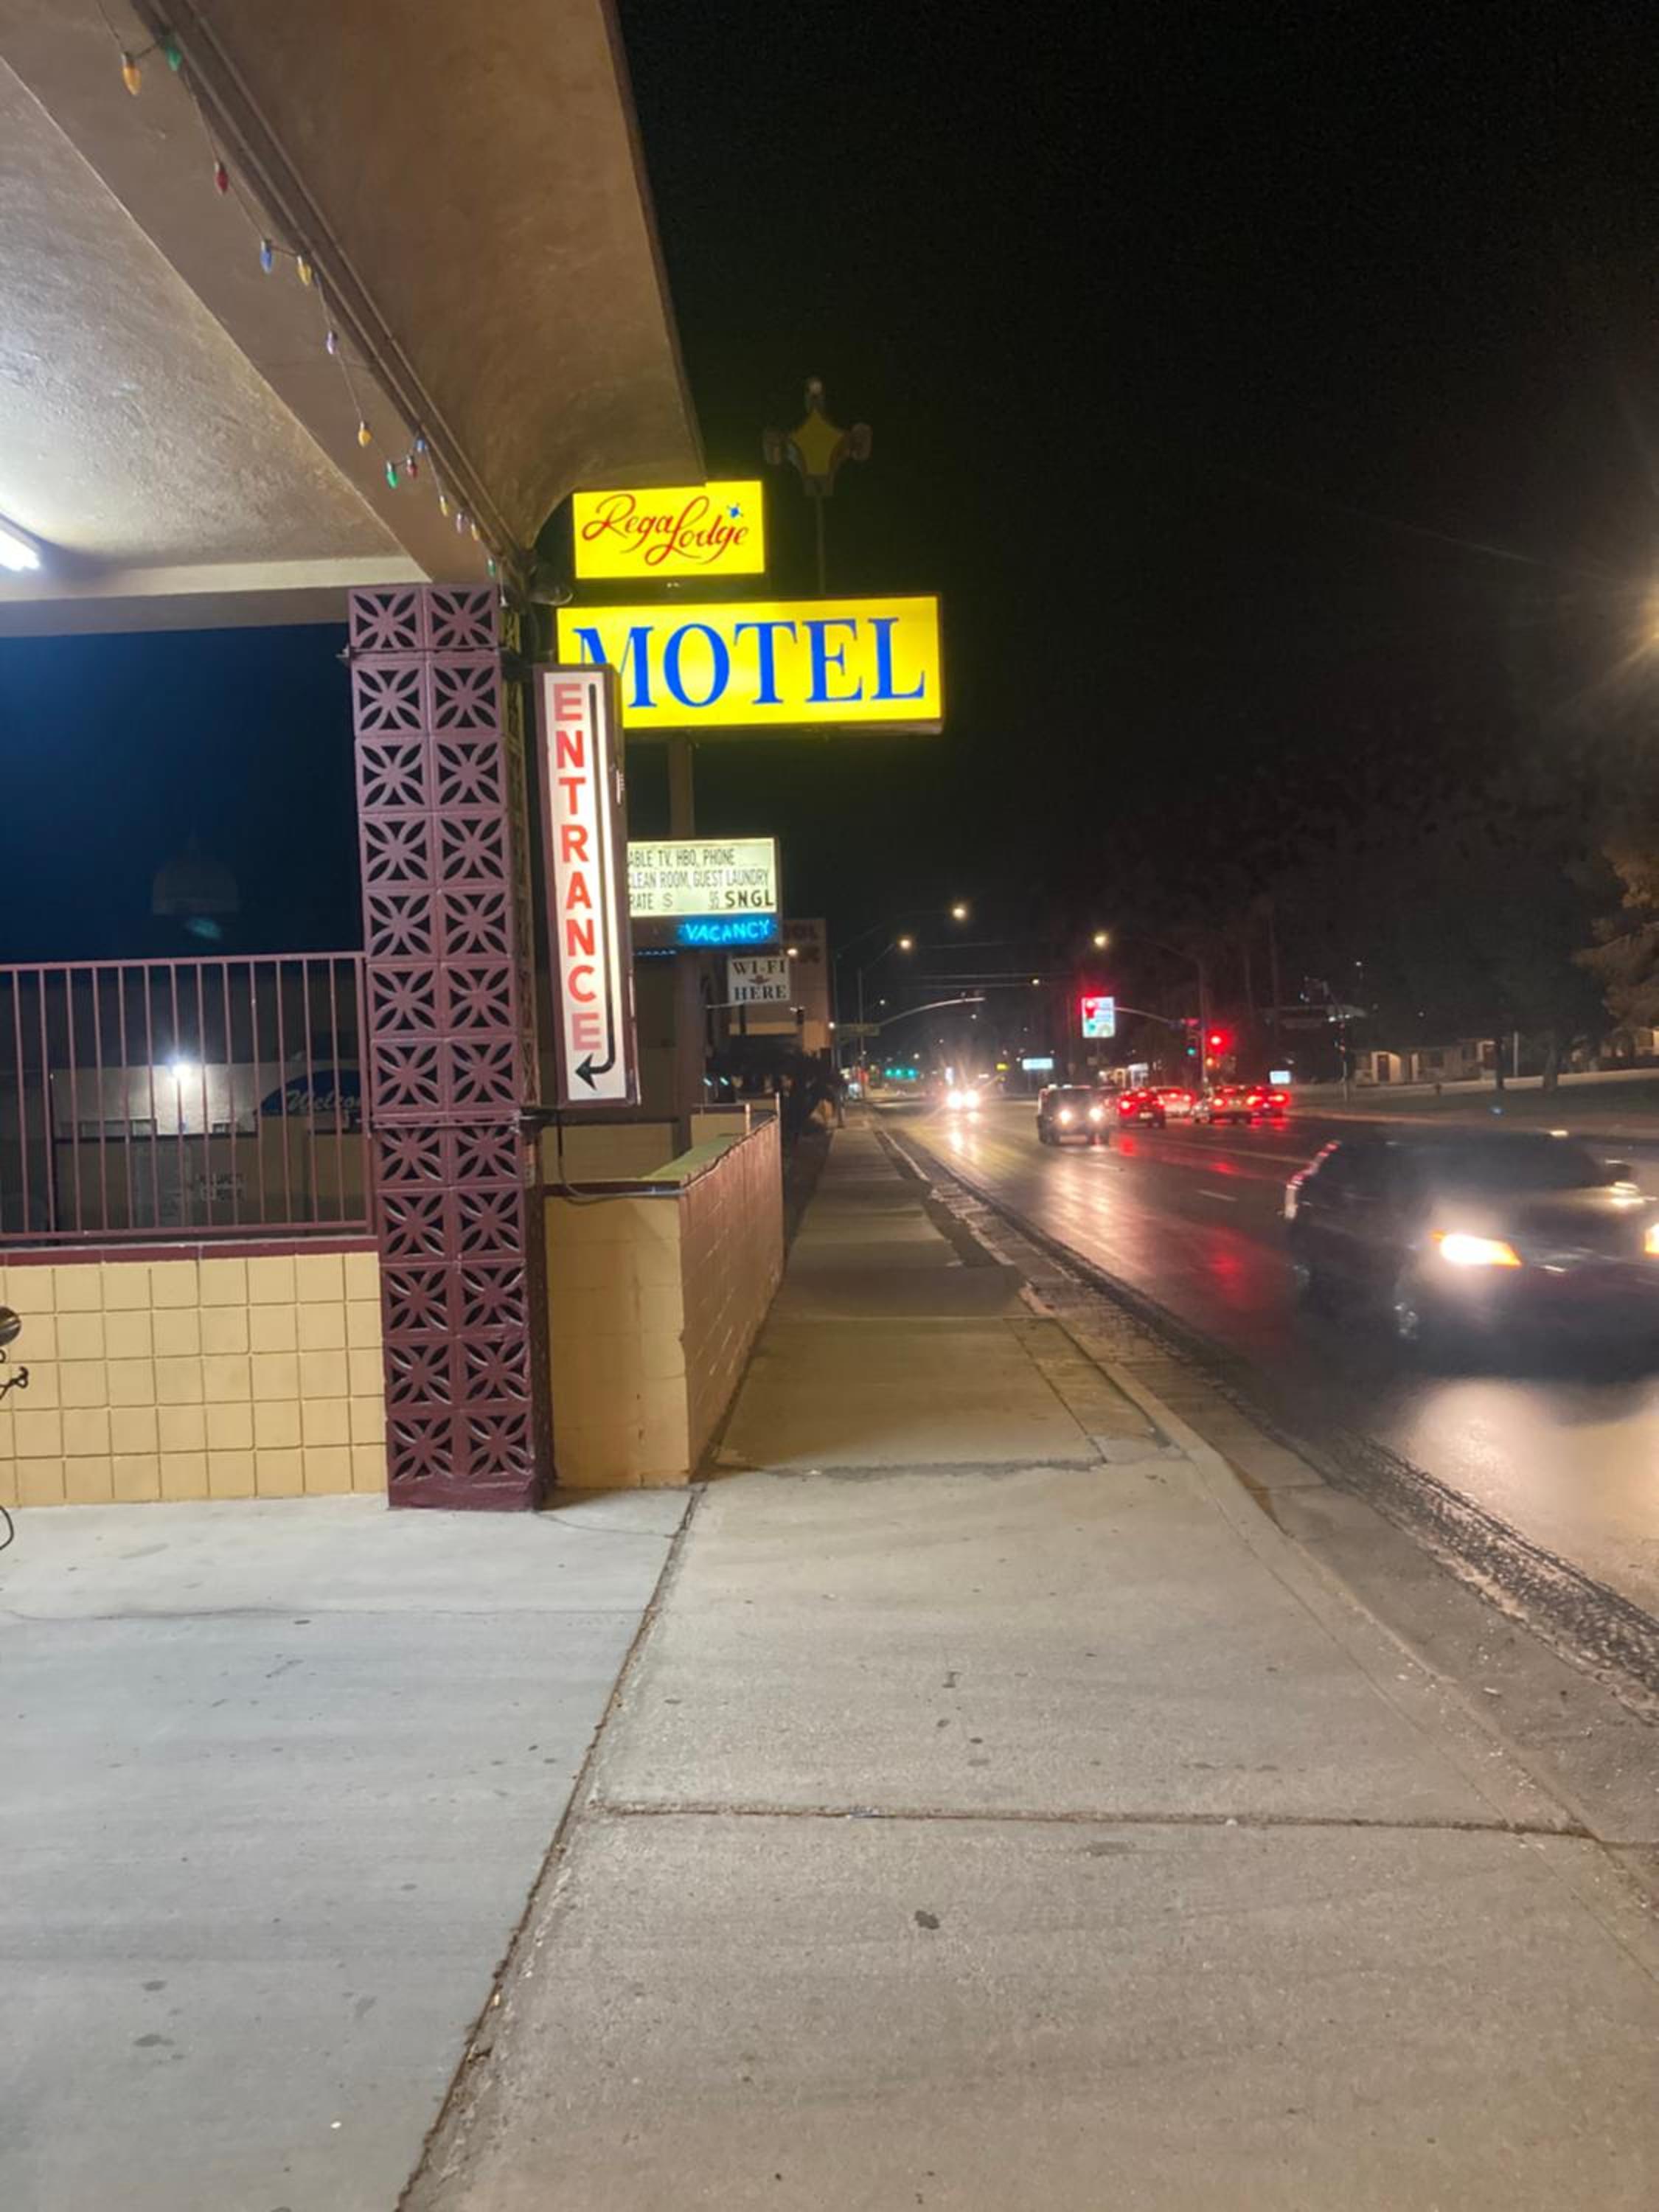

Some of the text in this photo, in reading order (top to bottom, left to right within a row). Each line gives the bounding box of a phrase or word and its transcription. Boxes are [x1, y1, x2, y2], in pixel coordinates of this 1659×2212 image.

[573, 617, 925, 709] MOTEL
[703, 847, 735, 866] PHONE
[552, 683, 602, 1052] ENTRANCE
[692, 869, 724, 888] GUEST
[725, 868, 769, 887] LAUNDRY
[630, 893, 654, 911] RATE
[724, 889, 775, 909] SNGL
[684, 919, 771, 943] VACANCY
[732, 959, 786, 975] WI-FI
[733, 984, 787, 1002] HERE
